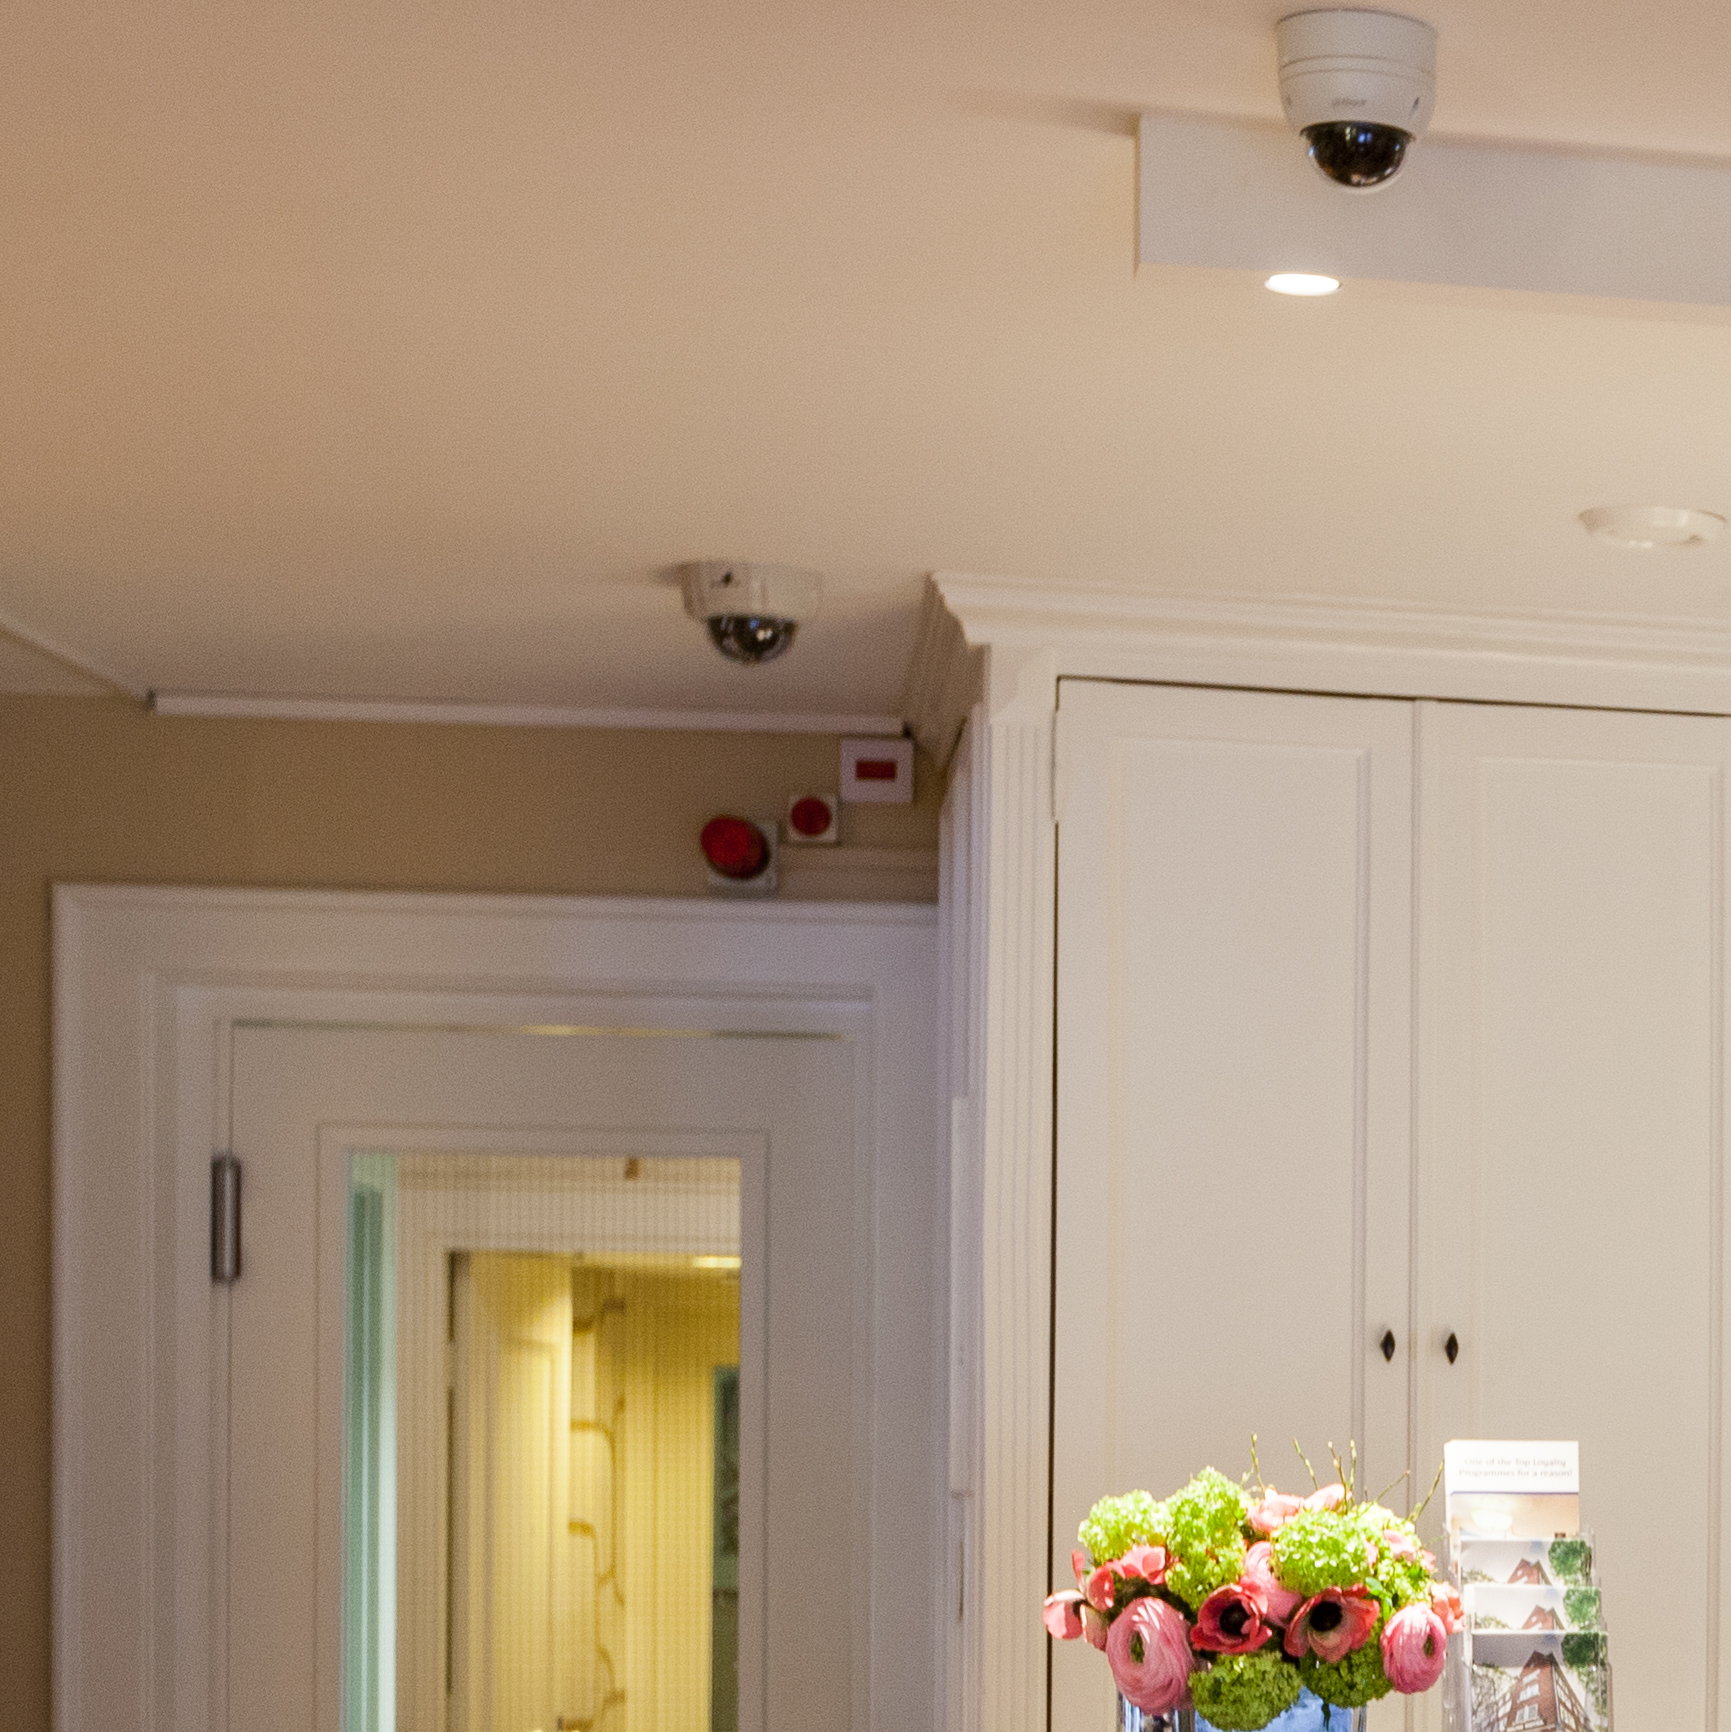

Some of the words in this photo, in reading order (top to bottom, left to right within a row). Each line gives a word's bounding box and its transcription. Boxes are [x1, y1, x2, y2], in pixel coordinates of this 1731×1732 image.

[1464, 1458, 1483, 1466] One
[1486, 1458, 1495, 1466] of
[1497, 1458, 1512, 1466] the
[1515, 1458, 1530, 1468] Top
[1533, 1457, 1567, 1468] Loyalty
[1458, 1469, 1515, 1478] Programmes
[1540, 1469, 1573, 1477] reason!
